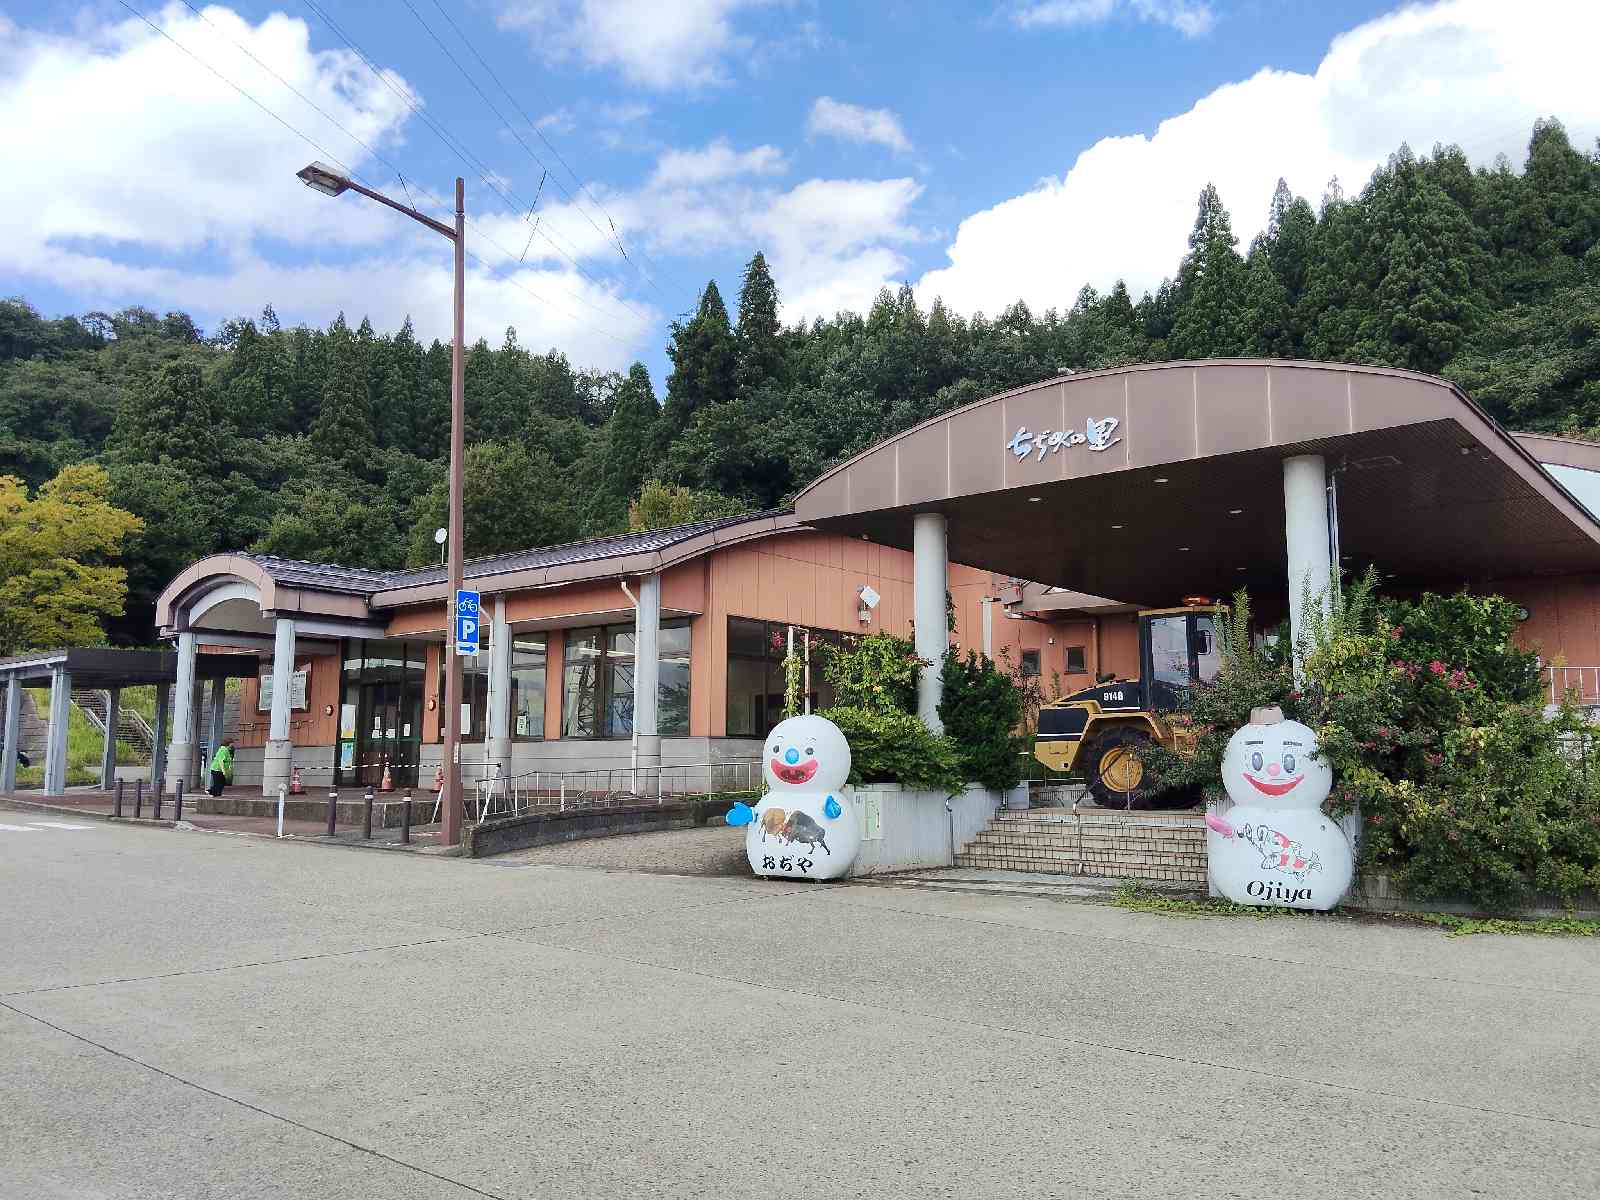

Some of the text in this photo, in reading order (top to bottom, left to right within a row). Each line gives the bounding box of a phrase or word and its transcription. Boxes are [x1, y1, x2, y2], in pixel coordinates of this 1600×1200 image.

[463, 620, 476, 640] P
[762, 854, 813, 874] おぢや
[1246, 880, 1312, 903] Ojiya
